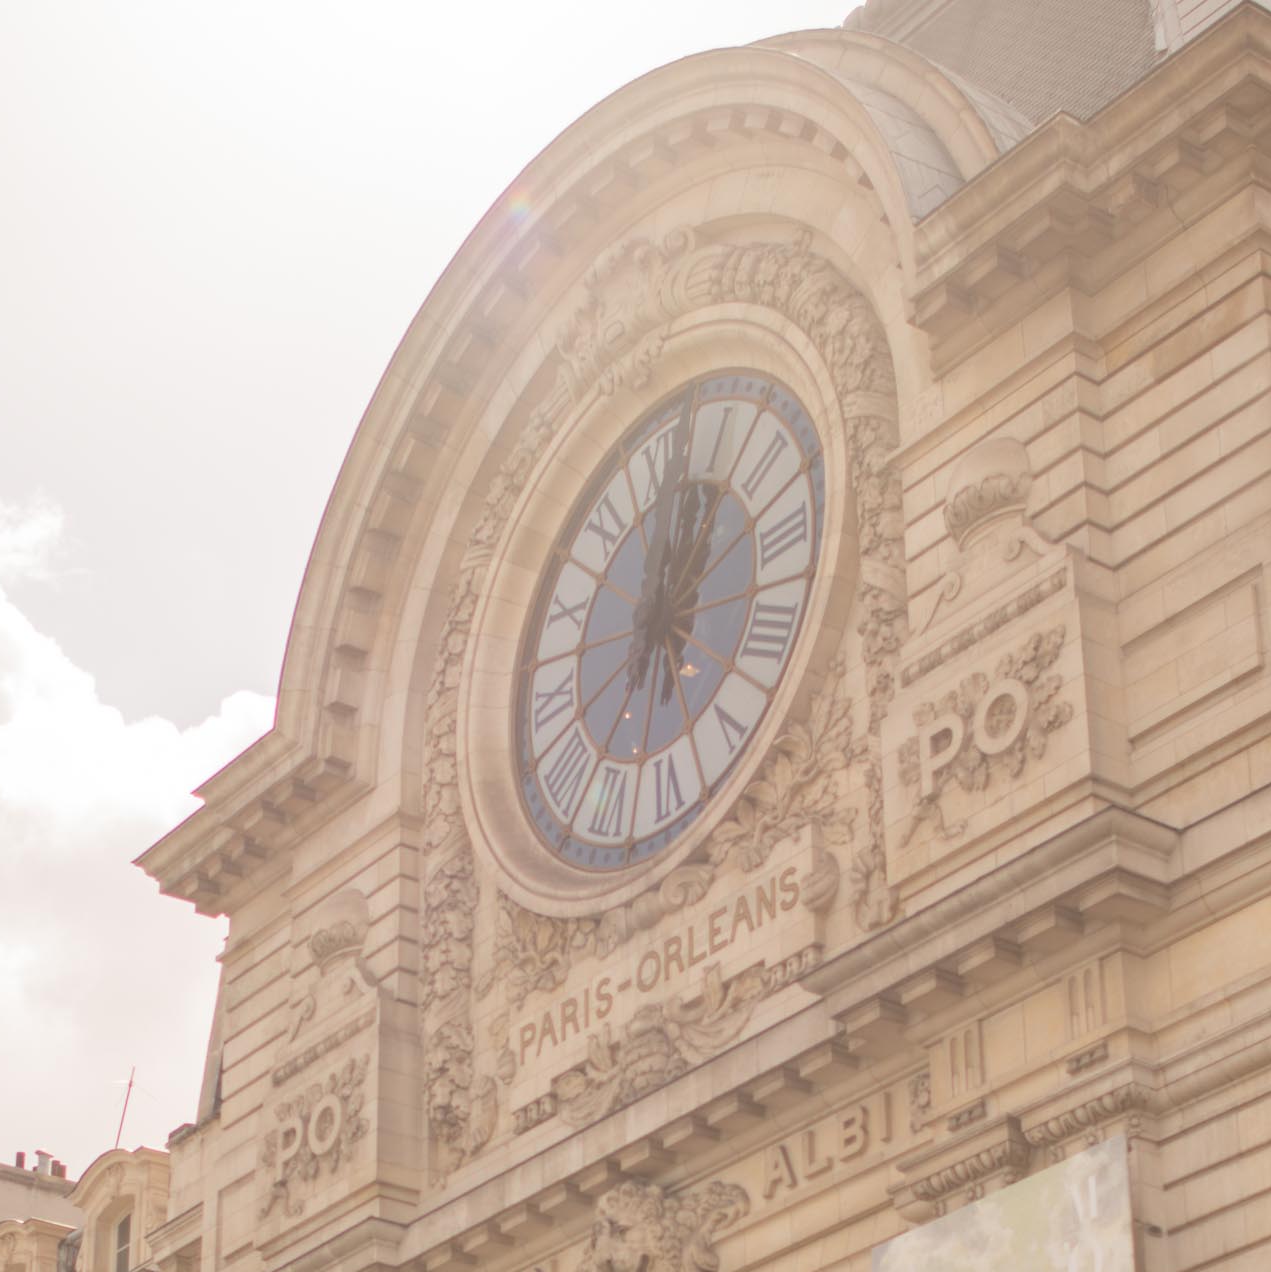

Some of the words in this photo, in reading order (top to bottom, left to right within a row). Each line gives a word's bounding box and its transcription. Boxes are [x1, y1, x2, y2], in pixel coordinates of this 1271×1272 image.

[741, 430, 789, 500] II
[584, 491, 628, 562] XI
[760, 500, 807, 571] III
[547, 595, 589, 631] X
[534, 668, 575, 733] IX
[710, 702, 749, 753] V
[919, 678, 1028, 799] PO
[587, 766, 628, 838] VII
[654, 753, 686, 824] VI
[762, 1090, 894, 1201] ALBI
